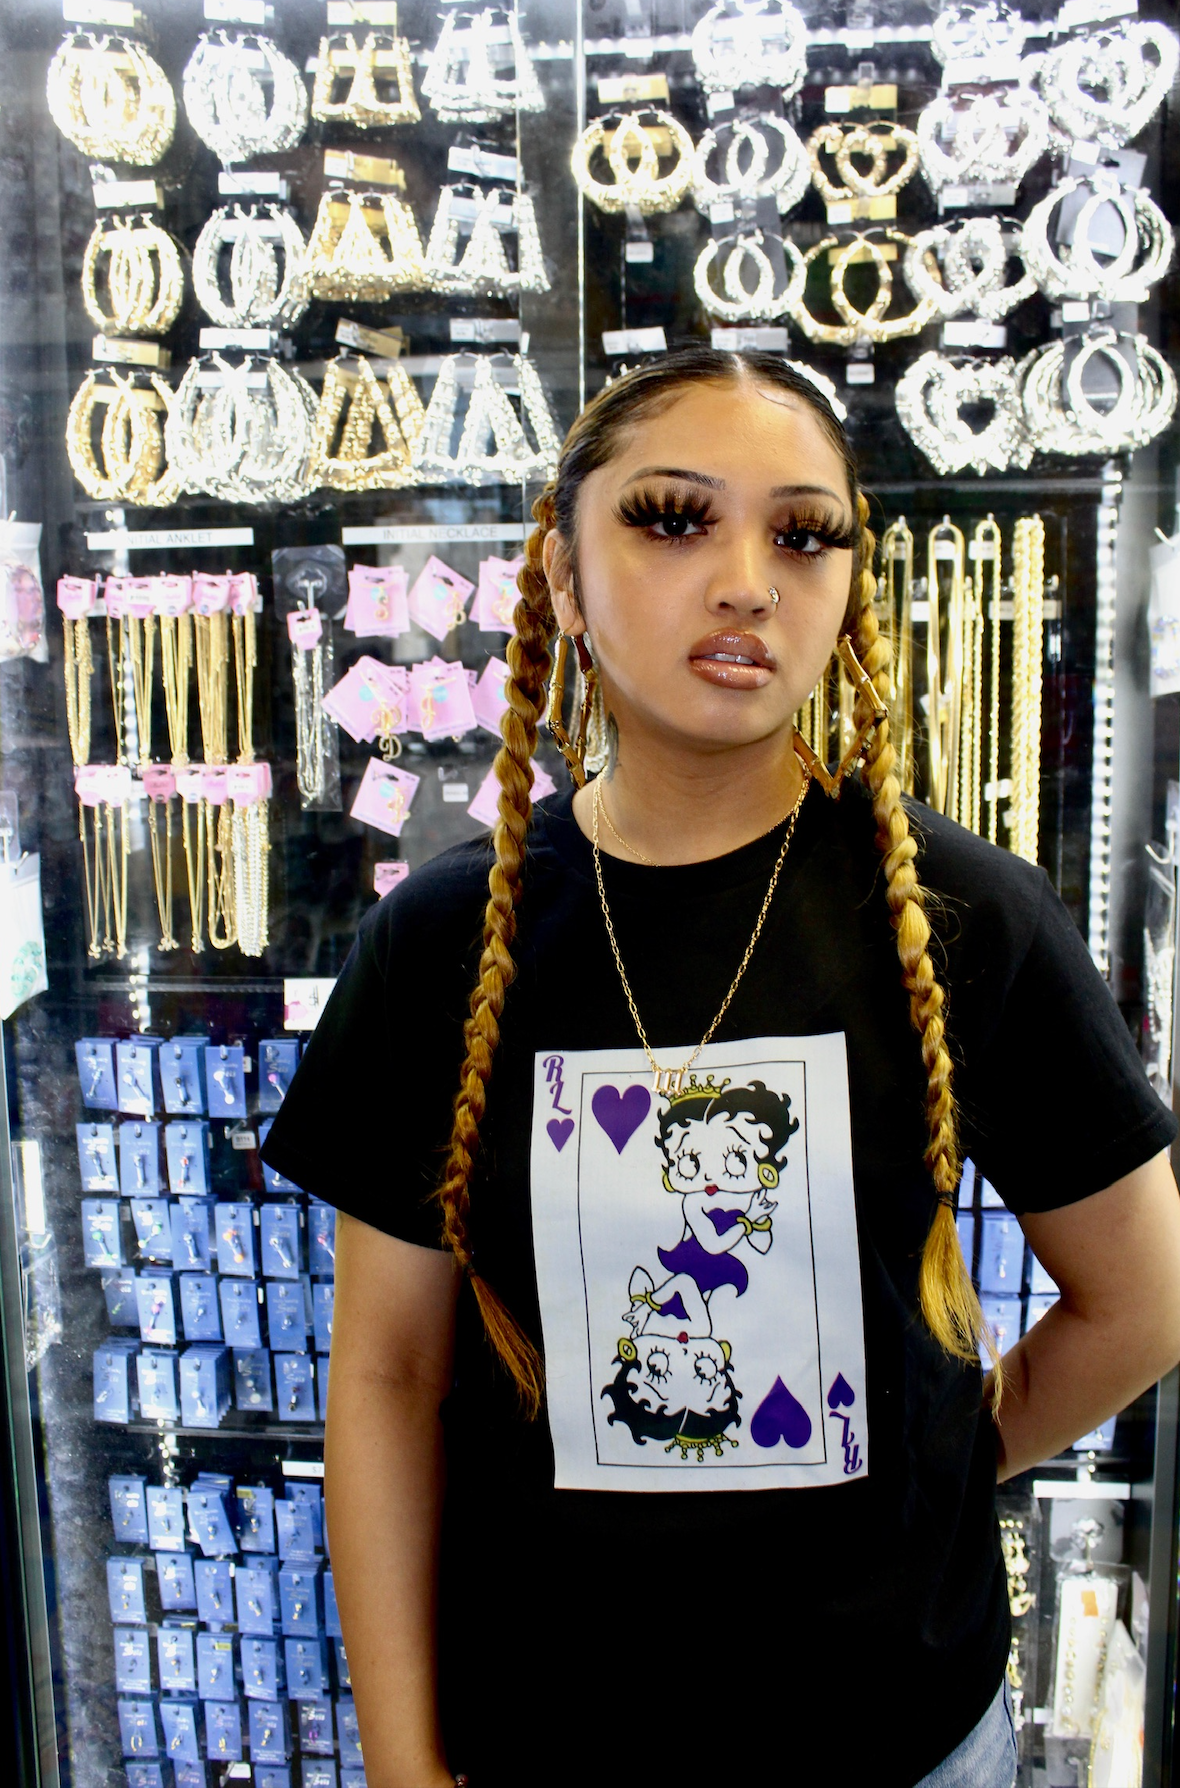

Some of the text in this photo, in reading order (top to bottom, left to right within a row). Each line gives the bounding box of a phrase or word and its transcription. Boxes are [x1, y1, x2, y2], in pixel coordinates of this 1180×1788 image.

[165, 531, 213, 544] ANKLET
[383, 526, 498, 541] INITIAL NECKLACE
